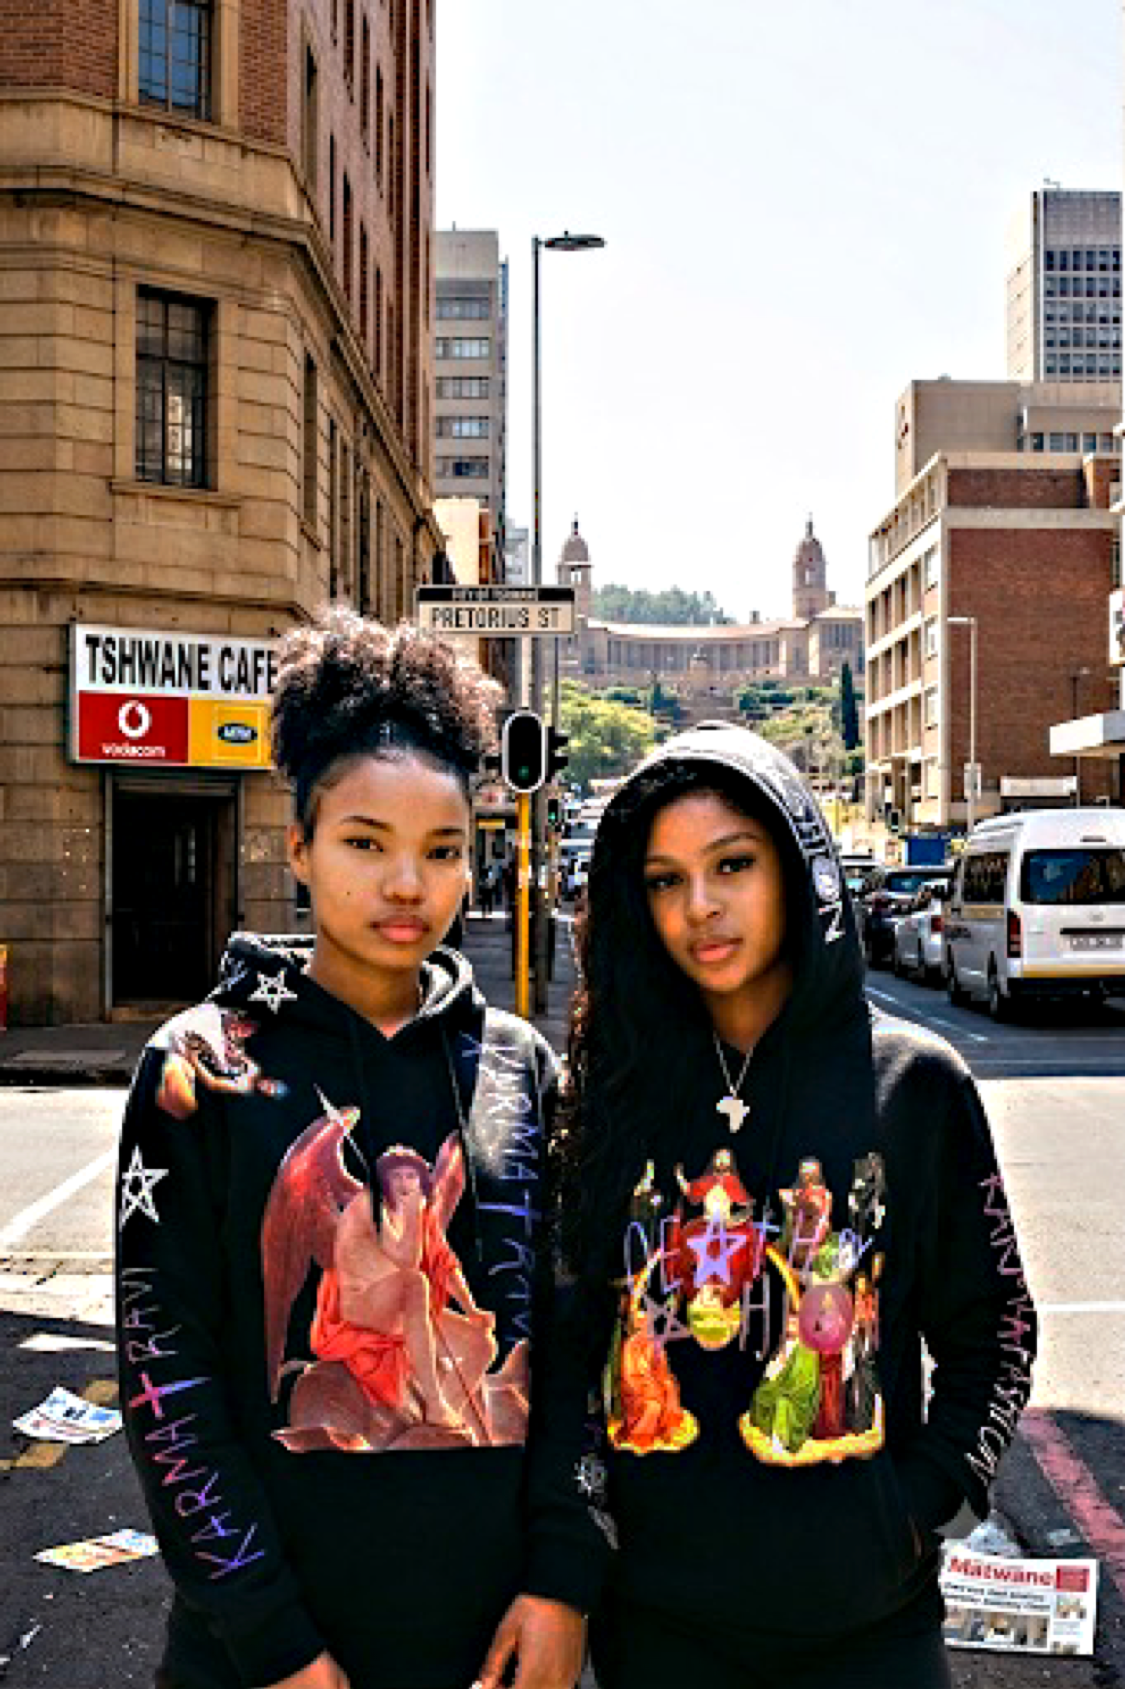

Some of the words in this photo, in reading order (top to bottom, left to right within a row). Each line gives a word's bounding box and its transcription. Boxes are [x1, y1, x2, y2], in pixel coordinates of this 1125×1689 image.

[431, 606, 530, 629] PRETORIUS
[537, 606, 561, 629] ST
[85, 633, 213, 691] TSHWANE
[218, 646, 278, 695] CAFE
